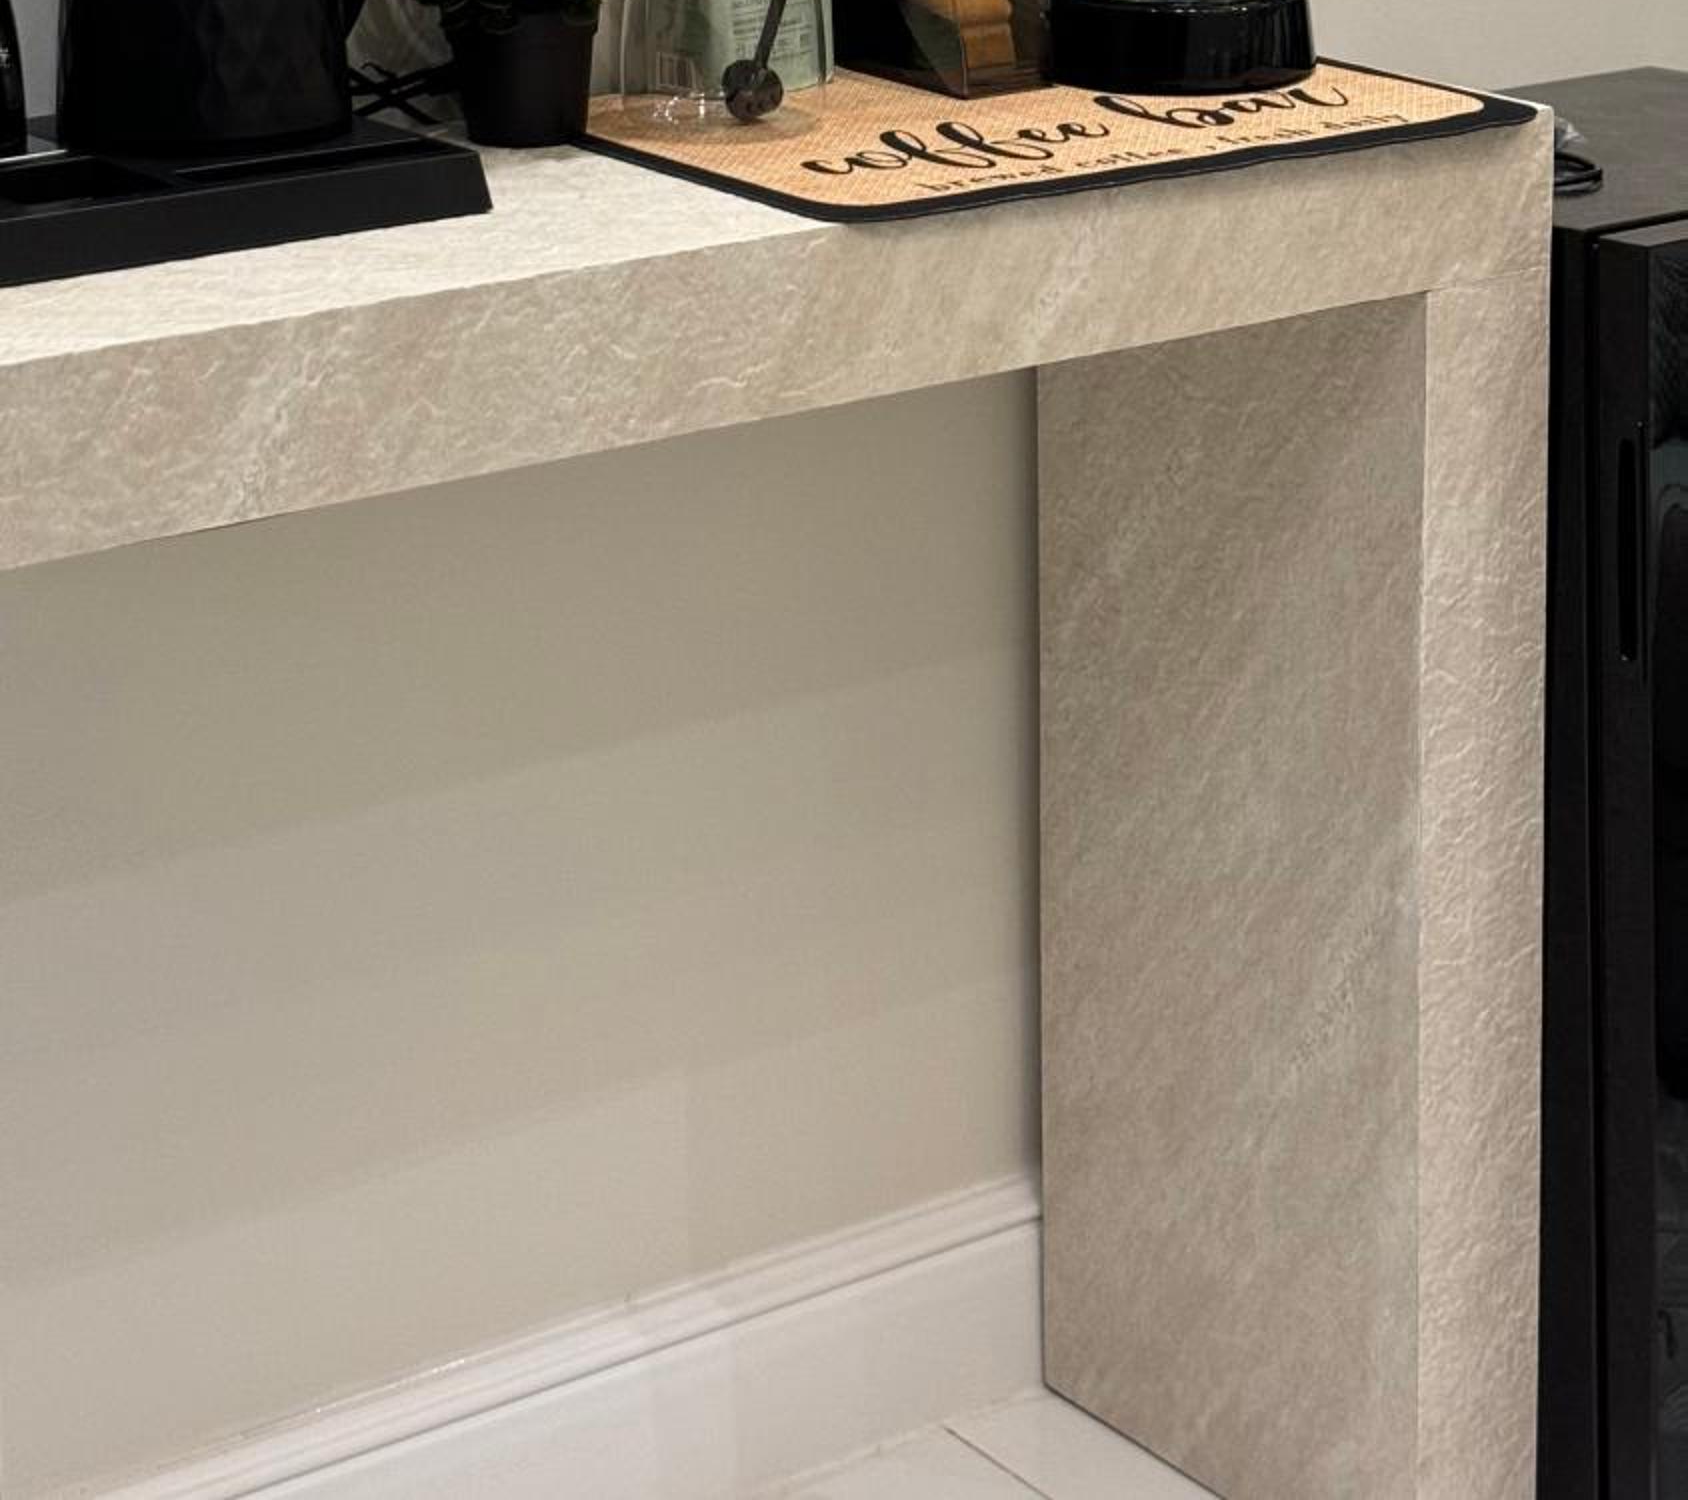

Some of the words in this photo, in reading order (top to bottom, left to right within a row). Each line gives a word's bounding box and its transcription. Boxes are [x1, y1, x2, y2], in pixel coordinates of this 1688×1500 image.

[800, 121, 1110, 175] coffee
[1092, 86, 1349, 129] bar
[915, 164, 1065, 192] brewed
[1076, 149, 1184, 168] coffee
